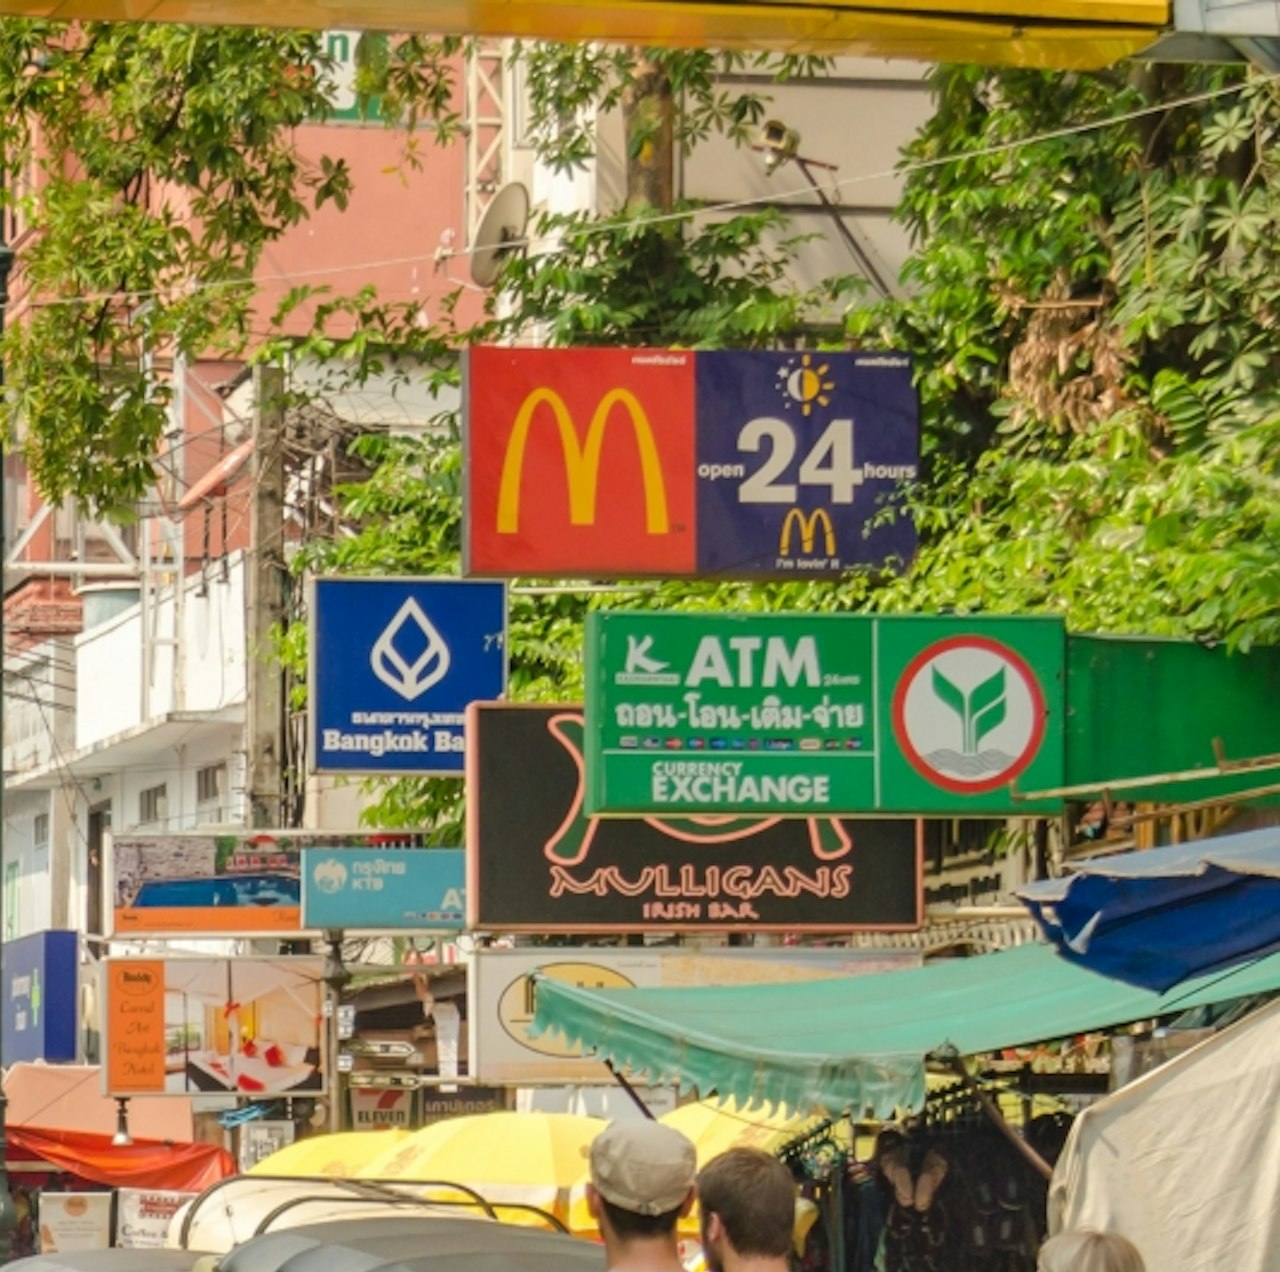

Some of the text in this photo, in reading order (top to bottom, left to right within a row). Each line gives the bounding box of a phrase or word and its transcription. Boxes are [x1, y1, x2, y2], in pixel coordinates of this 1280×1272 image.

[697, 416, 917, 504] open 24 hours
[684, 635, 822, 688] ATM
[322, 729, 429, 757] Bangkok
[651, 761, 744, 777] CURRENCY
[651, 776, 830, 804] EXCHANGE
[352, 876, 384, 891] KTB
[550, 865, 854, 899] MULLIGANS
[440, 888, 468, 910] A
[642, 901, 761, 920] IRISH BAR
